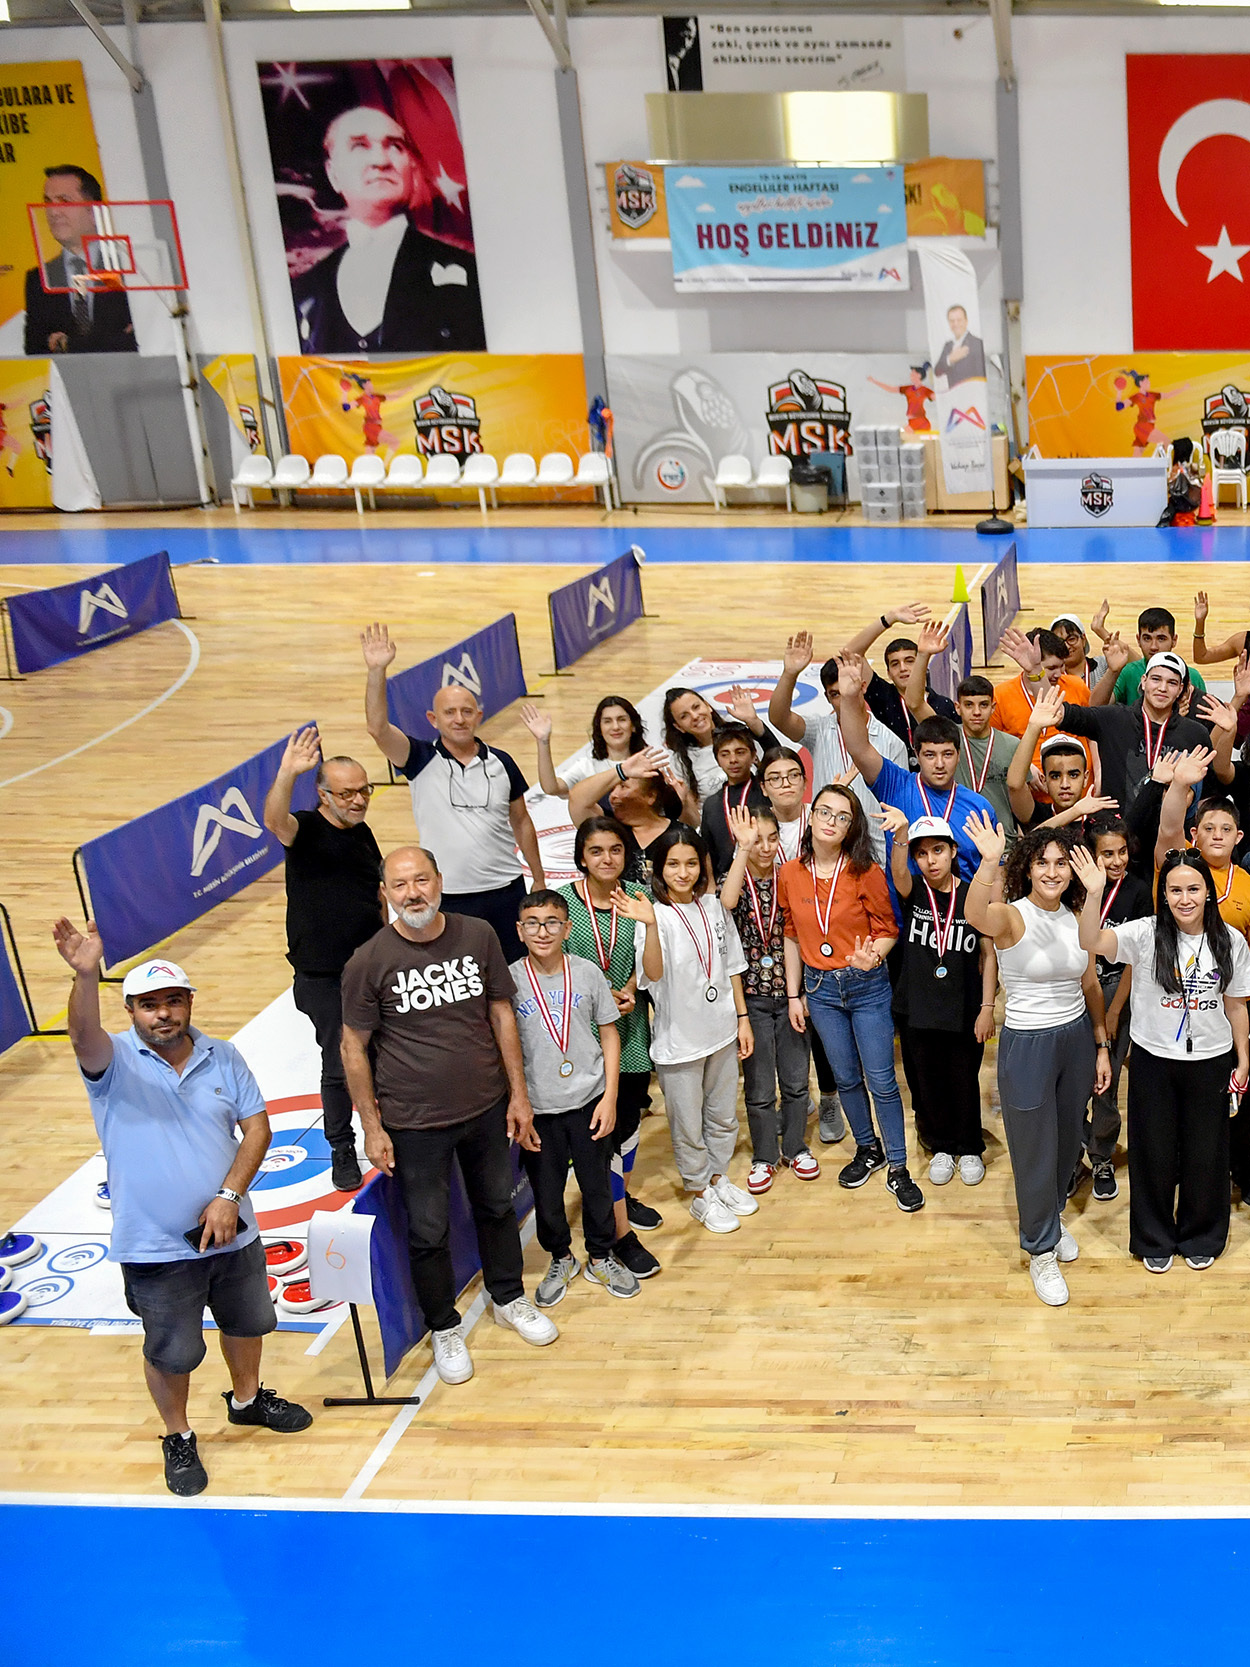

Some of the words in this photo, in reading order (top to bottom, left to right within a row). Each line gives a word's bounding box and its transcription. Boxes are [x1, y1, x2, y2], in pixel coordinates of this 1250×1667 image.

[55, 83, 75, 104] VE
[696, 223, 749, 257] HOŞ
[758, 221, 880, 249] GELDİNİZ
[417, 425, 484, 454] MSK
[767, 421, 854, 456] MSK
[1081, 492, 1114, 507] MSK
[909, 917, 977, 953] Hello
[392, 955, 480, 995] JACK&
[395, 975, 485, 1014] JONES
[548, 990, 583, 1009] YOK
[326, 1238, 347, 1270] 6
